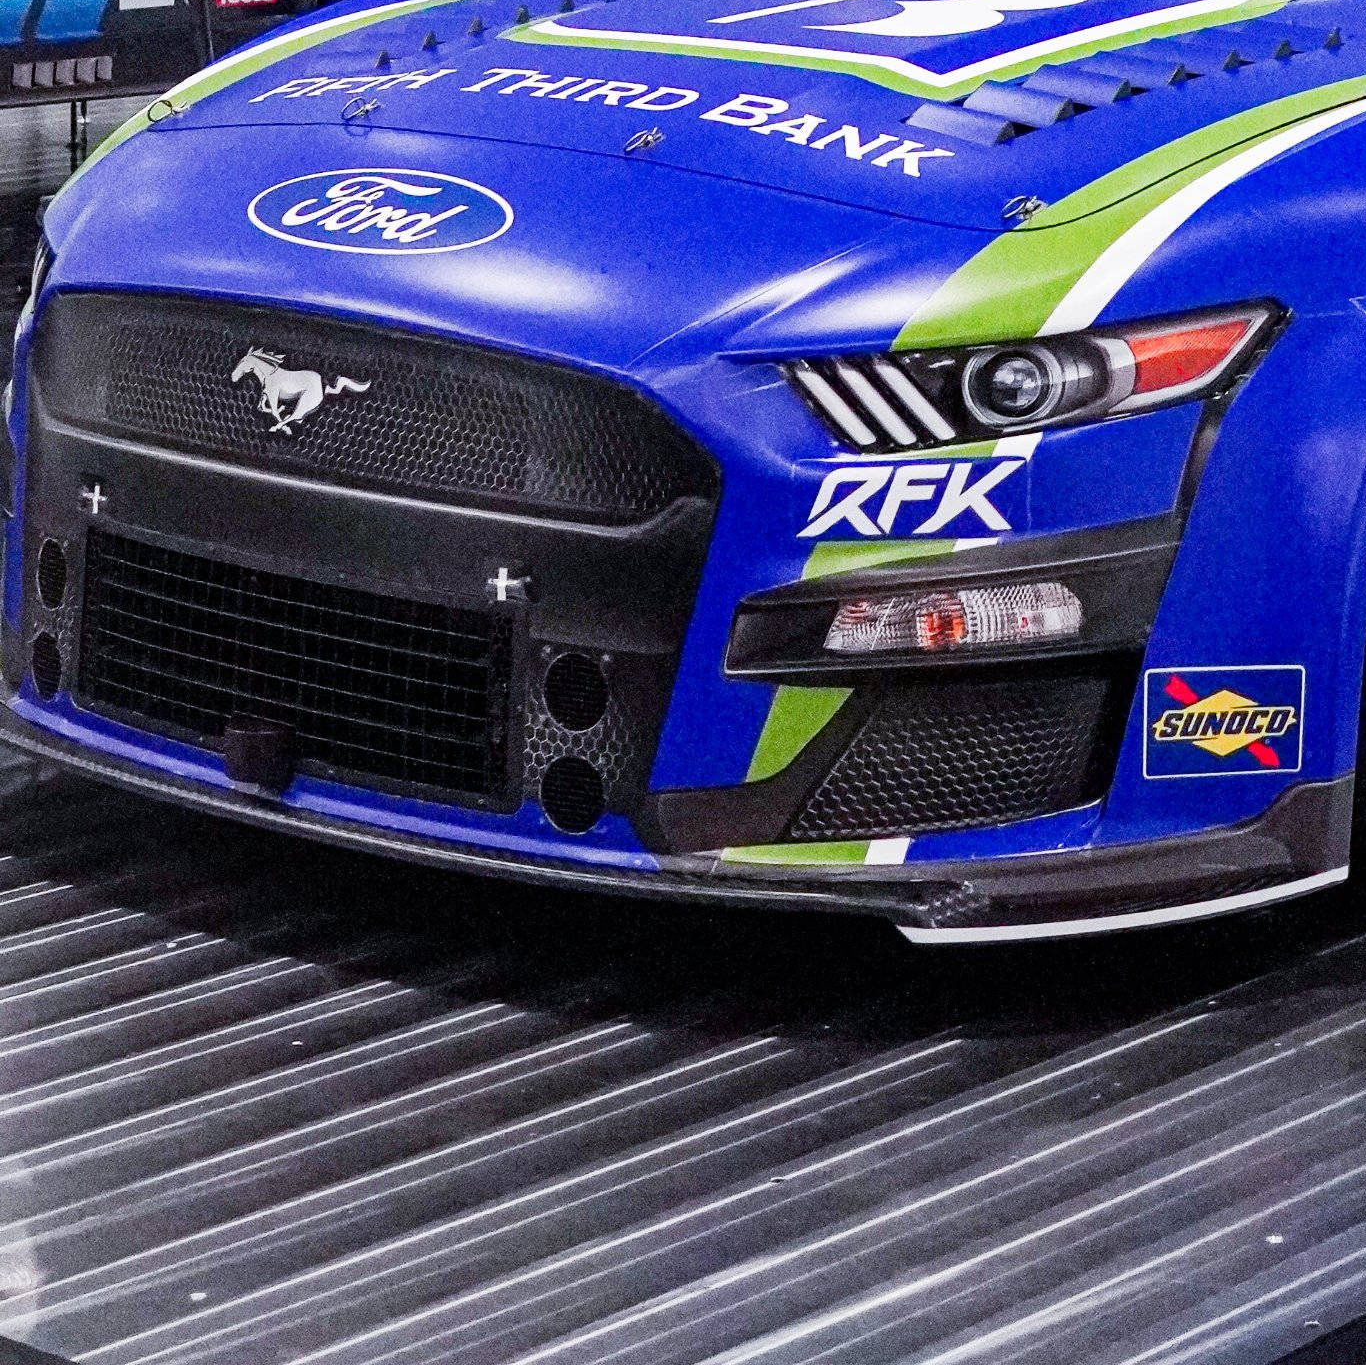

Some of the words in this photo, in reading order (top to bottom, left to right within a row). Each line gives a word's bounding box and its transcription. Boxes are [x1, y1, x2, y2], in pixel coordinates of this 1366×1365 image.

[249, 67, 457, 105] FIFTH
[460, 66, 704, 114] THIRD
[700, 93, 955, 178] BANK
[281, 176, 469, 243] Ford
[797, 461, 1027, 538] RFK
[1158, 706, 1292, 739] SUNOCO
